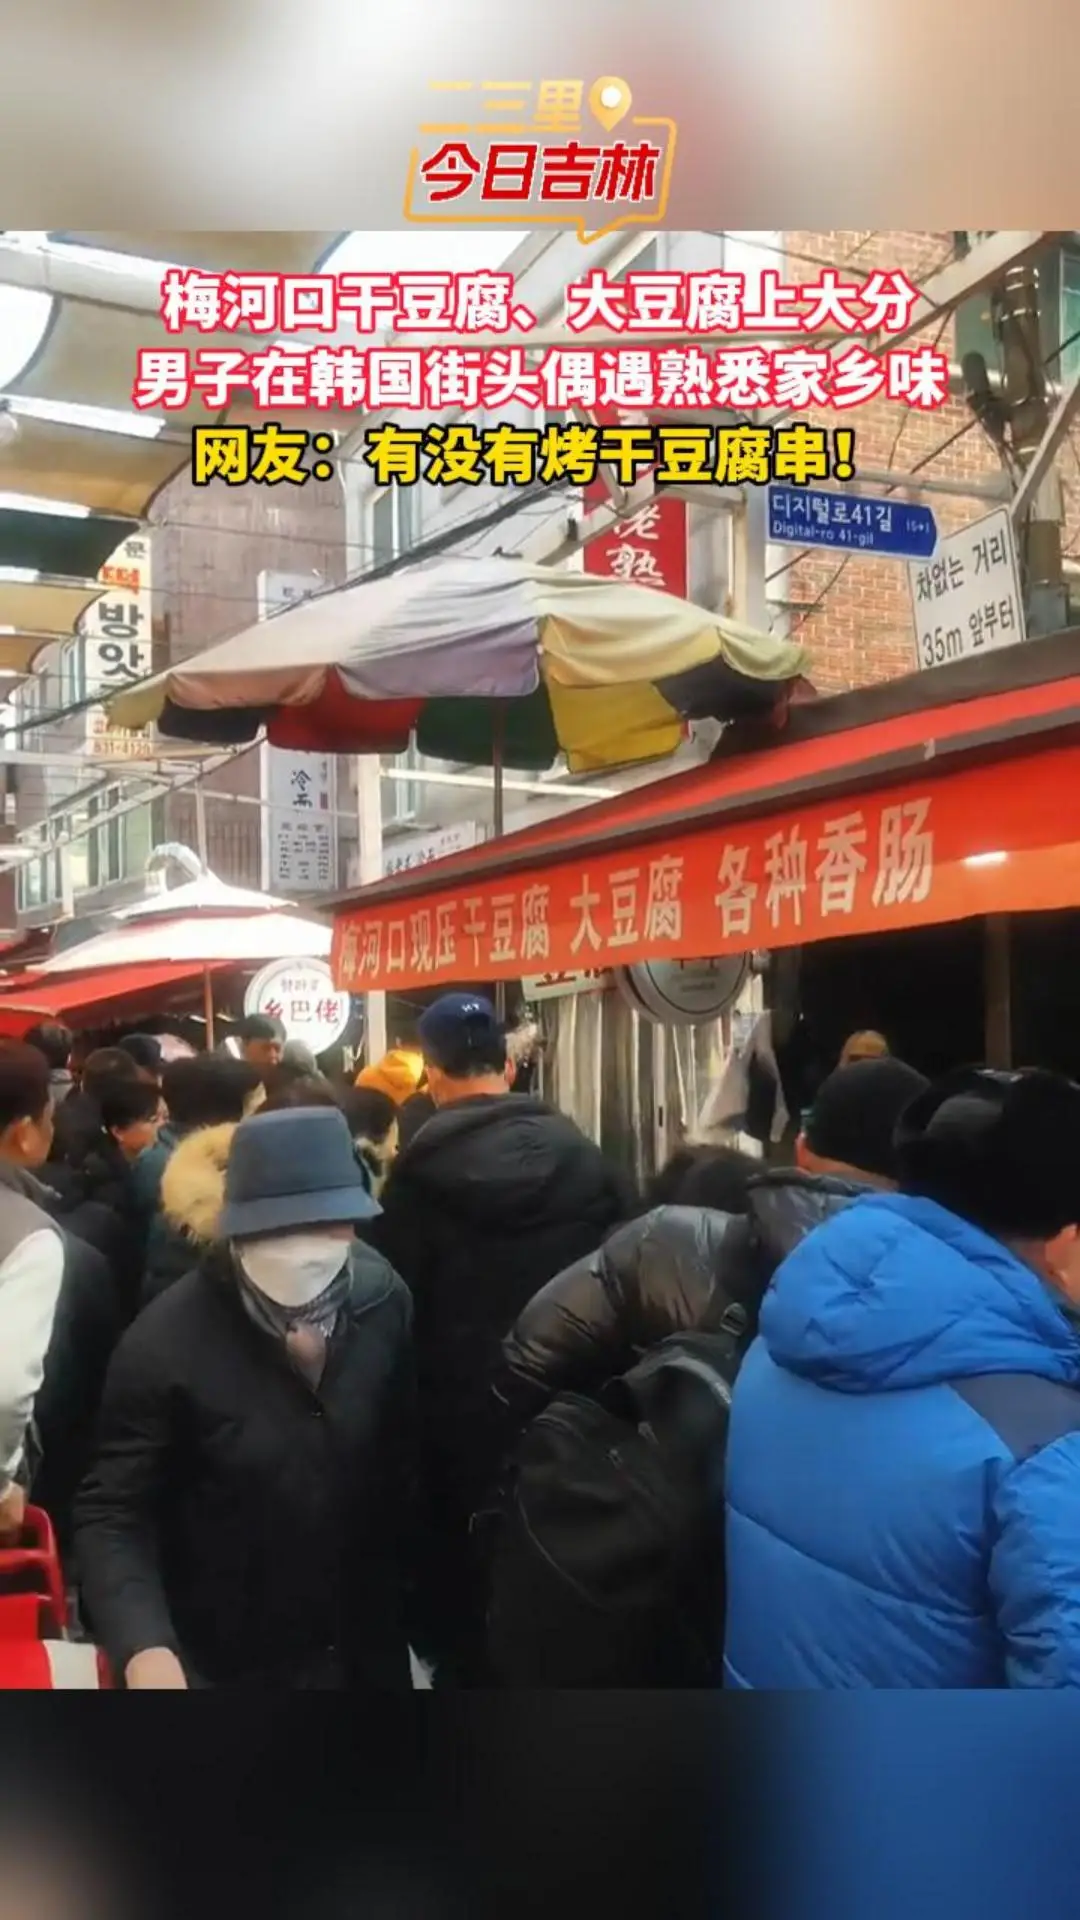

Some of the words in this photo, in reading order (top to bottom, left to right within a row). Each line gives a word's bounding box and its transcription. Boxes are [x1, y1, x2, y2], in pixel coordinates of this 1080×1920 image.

[773, 493, 892, 533] 디지털로41길
[773, 520, 835, 541] Digital-ro
[838, 528, 874, 547] 41-gil
[916, 555, 965, 602] 차없는
[972, 527, 1008, 576] 거리
[922, 624, 963, 667] 35m
[968, 593, 1016, 648] 앞부터
[569, 854, 684, 953] 大豆腐
[714, 797, 935, 939] 各种香肠
